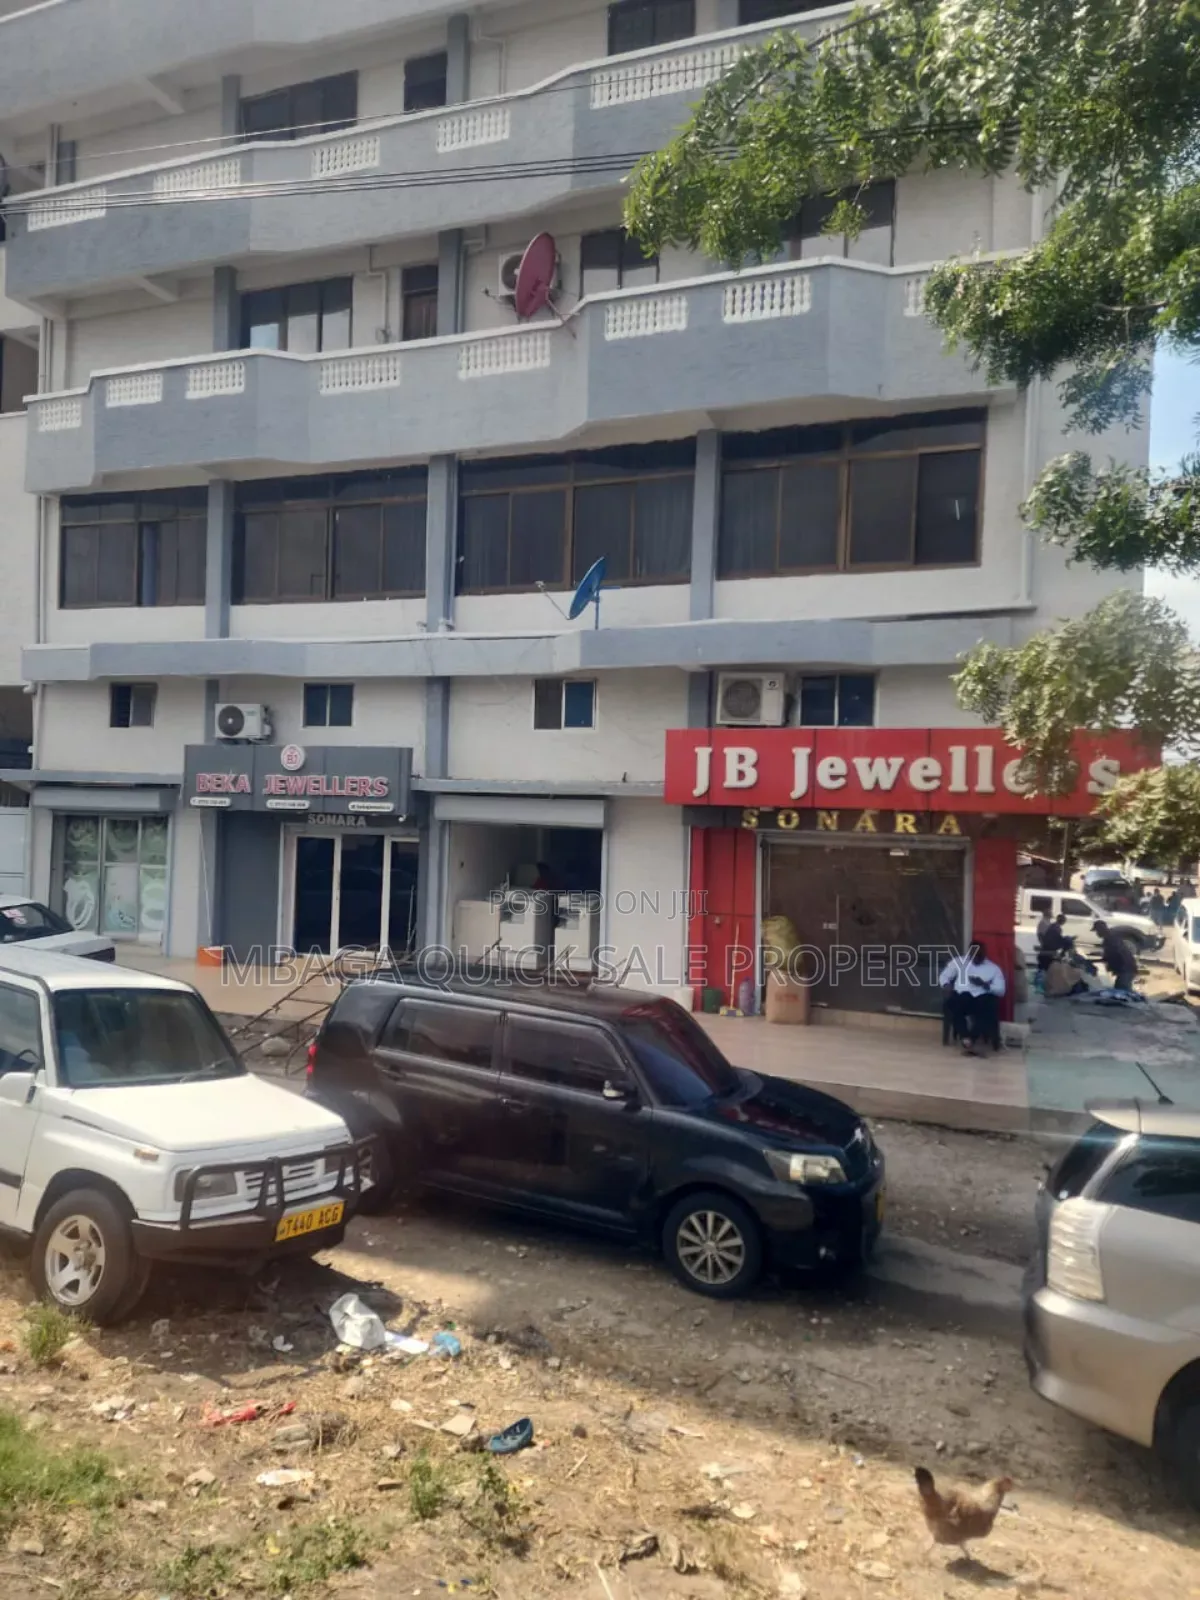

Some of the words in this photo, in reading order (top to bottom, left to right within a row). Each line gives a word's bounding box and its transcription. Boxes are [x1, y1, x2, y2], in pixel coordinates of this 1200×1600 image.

[196, 773, 252, 793] BEKA
[263, 774, 389, 797] JEWELLERS
[693, 746, 758, 797] JB
[790, 745, 1120, 799] Jewelles
[742, 808, 962, 835] SONARA
